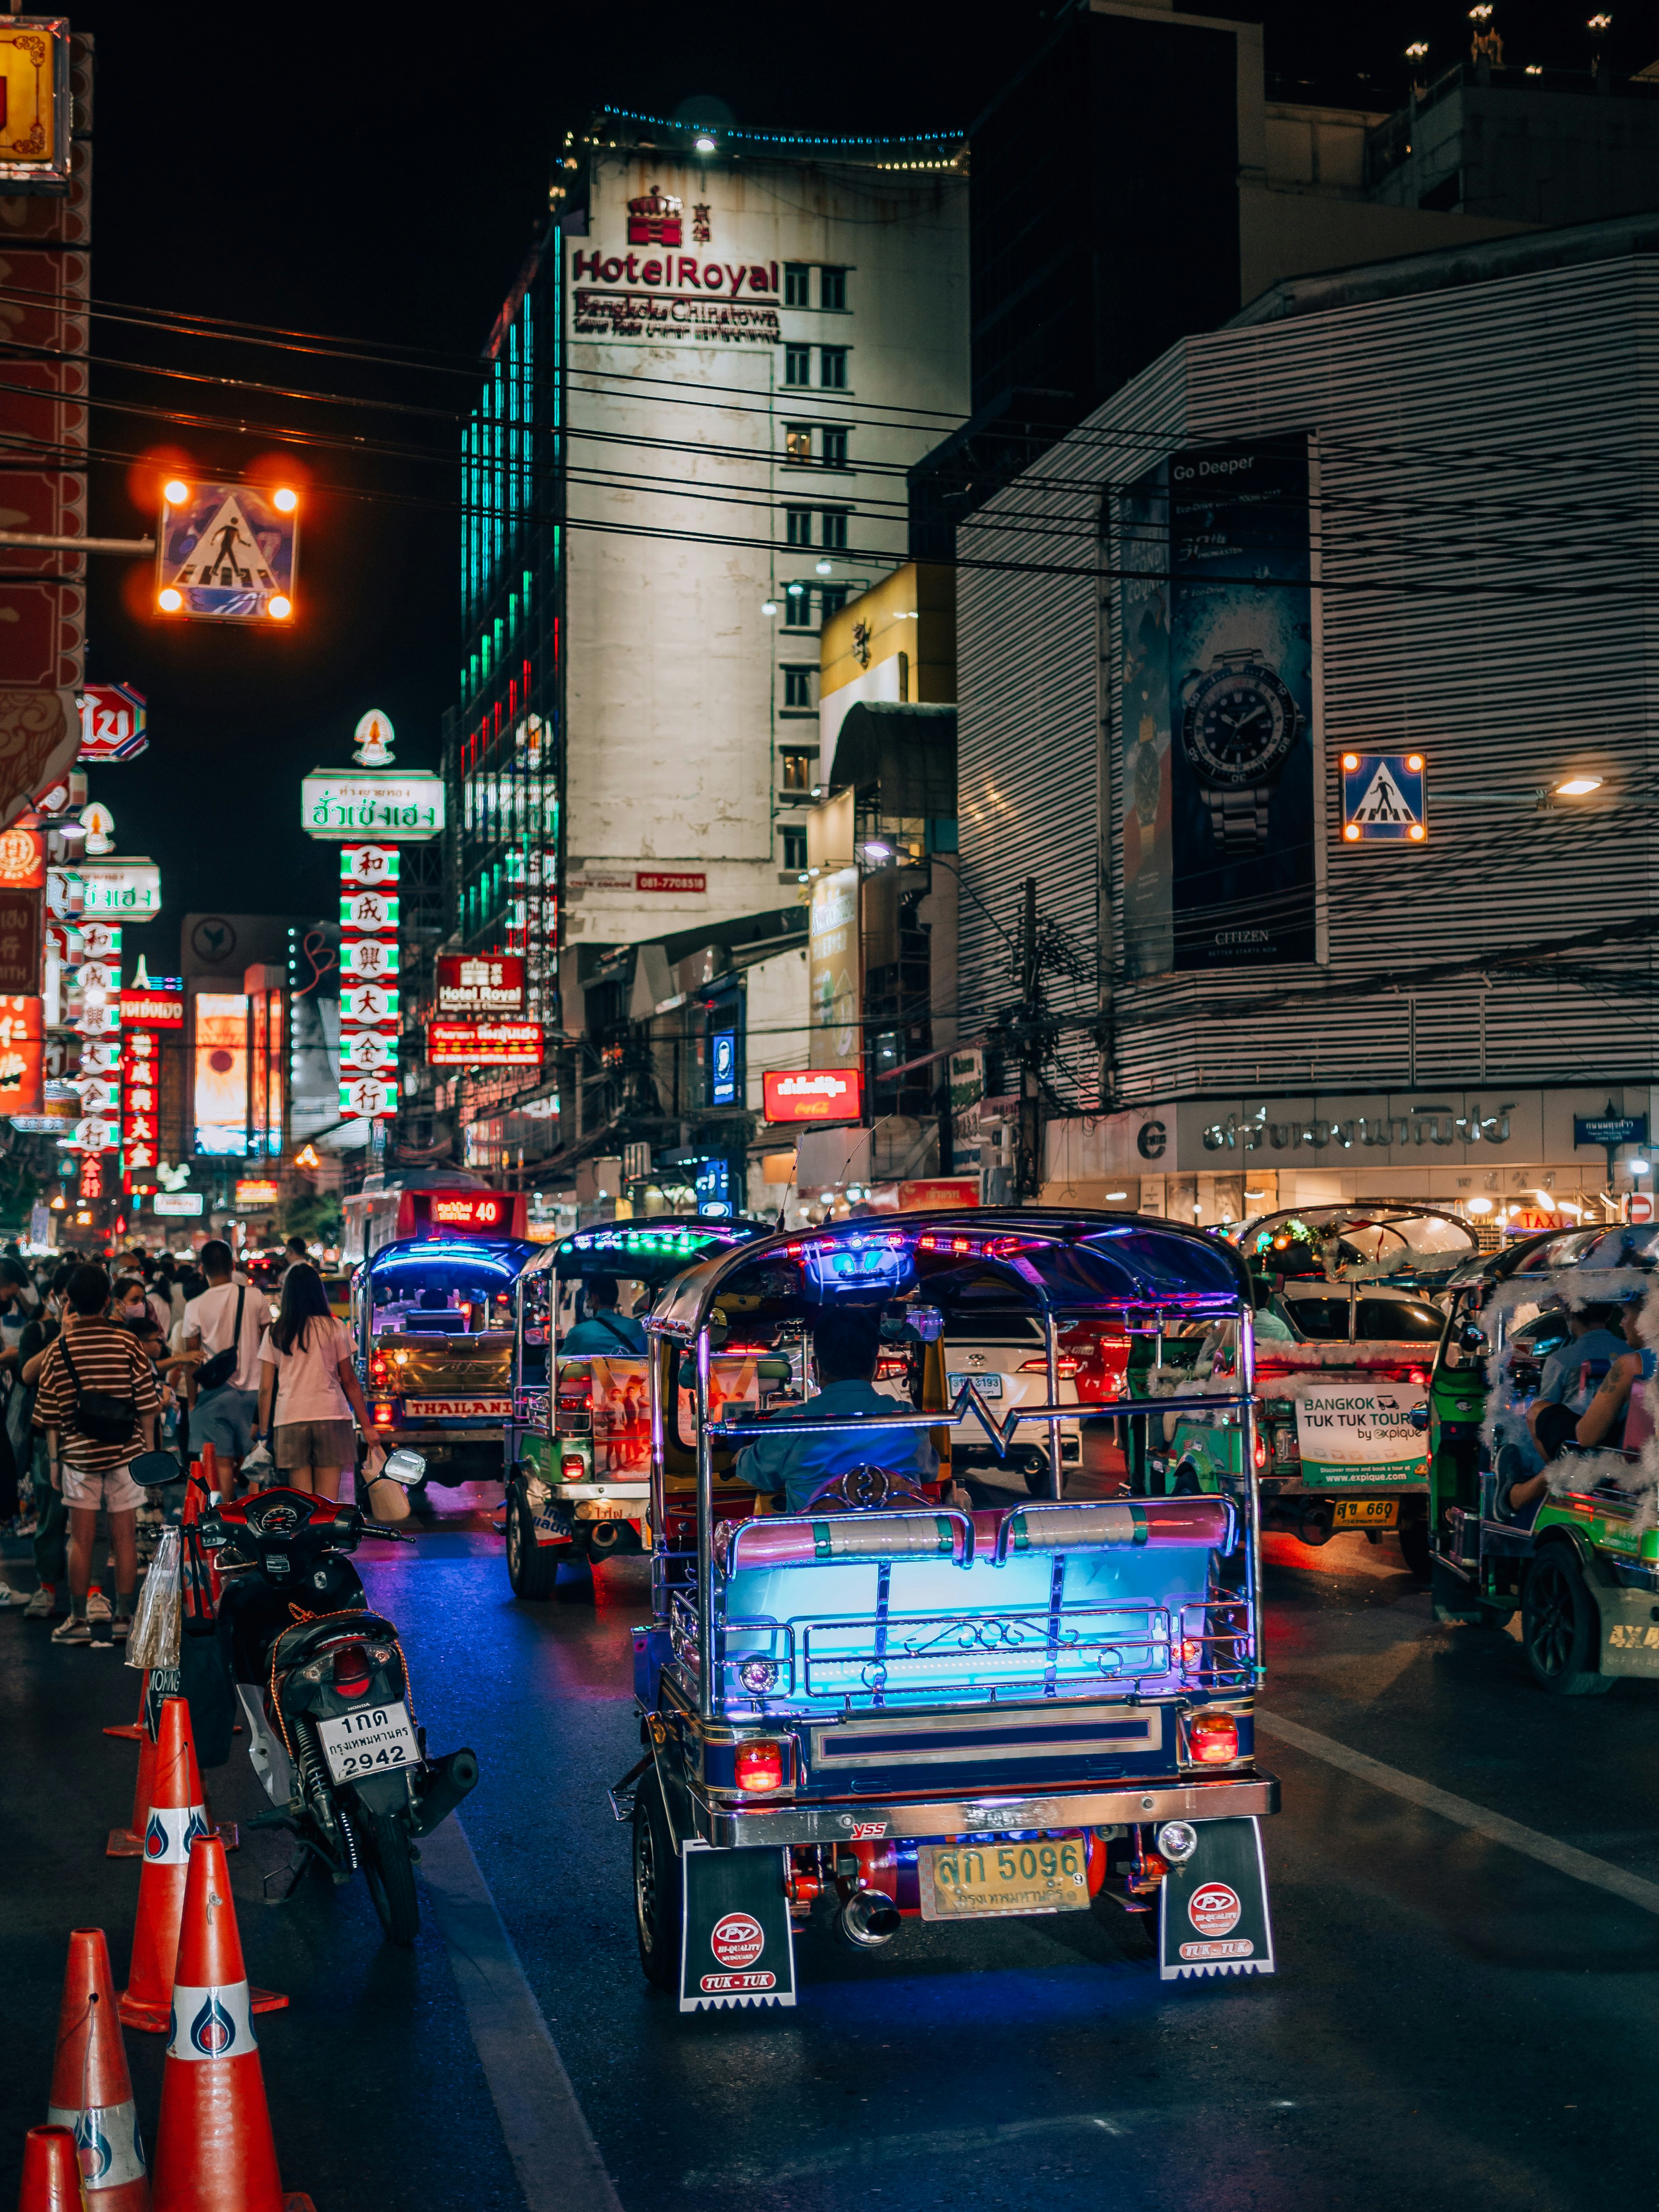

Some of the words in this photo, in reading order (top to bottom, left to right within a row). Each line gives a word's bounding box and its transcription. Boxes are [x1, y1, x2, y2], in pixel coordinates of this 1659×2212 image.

[573, 249, 672, 287] Hotel
[679, 255, 779, 297] Royal
[1174, 465, 1195, 481] Go
[1198, 456, 1255, 476] Deeper
[1214, 930, 1269, 945] CITIZEN
[440, 986, 477, 1000] Hotel
[480, 986, 521, 1001] Royal
[476, 1203, 496, 1221] 40
[1523, 1213, 1563, 1228] TAXI
[1305, 1398, 1375, 1411] BANGKOK
[1305, 1415, 1333, 1427] TUK
[1337, 1414, 1366, 1427] TUK
[1370, 1413, 1410, 1425] TOUR
[1358, 1429, 1372, 1441] by
[1374, 1429, 1422, 1441] expique
[1326, 1473, 1407, 1482] www.expique.com
[341, 1710, 388, 1734] 1กด
[329, 1727, 409, 1755] กรุงเทพมหานคร
[343, 1745, 406, 1776] 2942
[939, 1851, 985, 1884] สก
[999, 1845, 1078, 1880] 5096
[1074, 1875, 1084, 1885] 9
[1201, 1896, 1227, 1909] PY
[1195, 1912, 1237, 1922] HI-QUALITY
[726, 1927, 751, 1941] PY
[717, 1944, 761, 1954] HI-QUALITY
